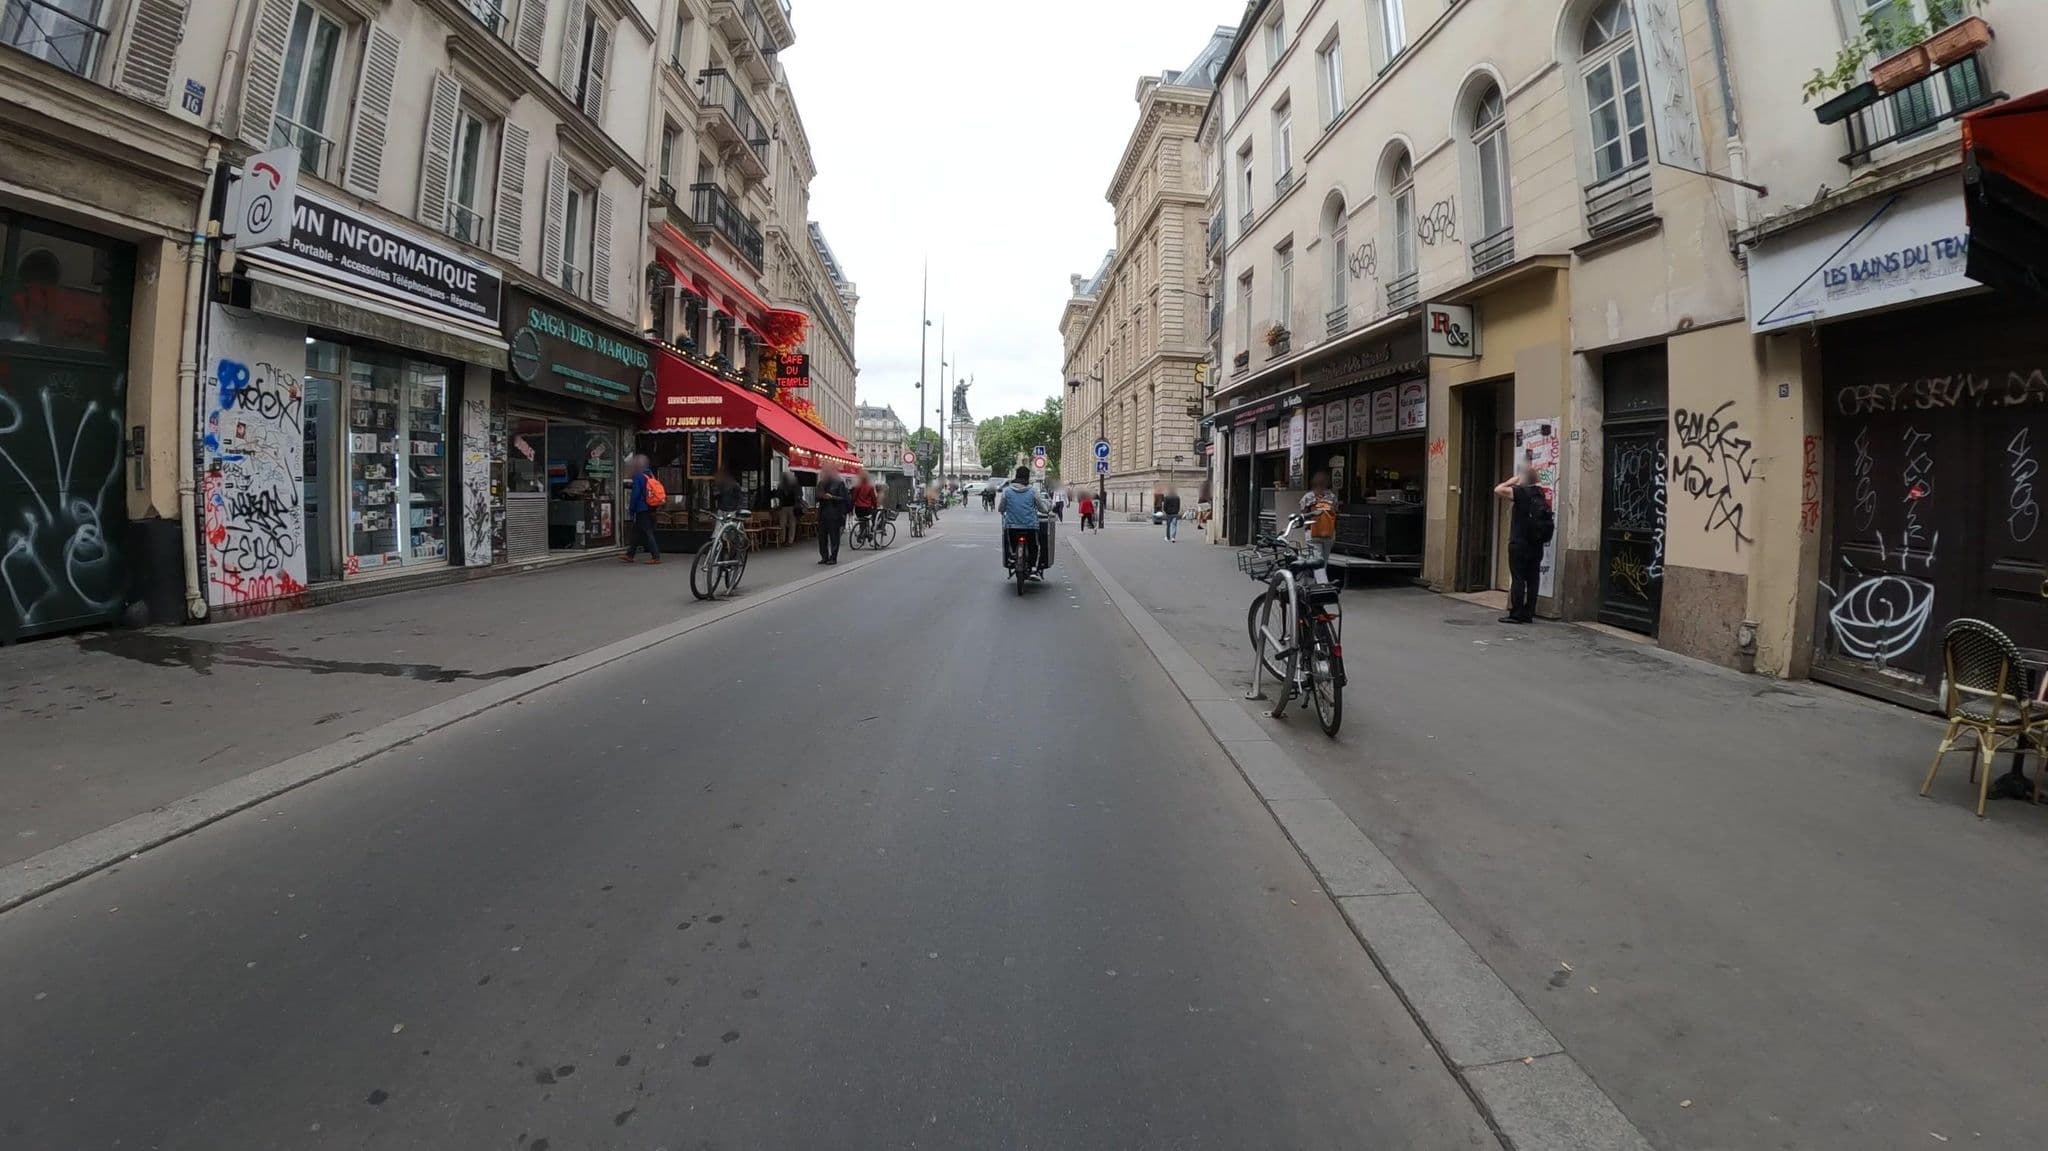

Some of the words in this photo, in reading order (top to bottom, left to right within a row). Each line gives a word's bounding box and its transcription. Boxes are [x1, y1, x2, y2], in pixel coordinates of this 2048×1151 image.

[186, 94, 199, 113] 16
[292, 237, 334, 262] Portable
[340, 255, 391, 282] Accessoires
[391, 272, 446, 300] Téléphoniques
[331, 218, 478, 294] INFORMATIQUE
[1823, 265, 1848, 288] LES
[1849, 251, 1900, 282] BAINS
[1902, 244, 1930, 269] DU
[528, 307, 567, 339] SAGA
[568, 324, 595, 350] DES
[596, 335, 649, 370] MARQUES
[776, 377, 808, 387] TEMPLE
[786, 366, 798, 375] DU
